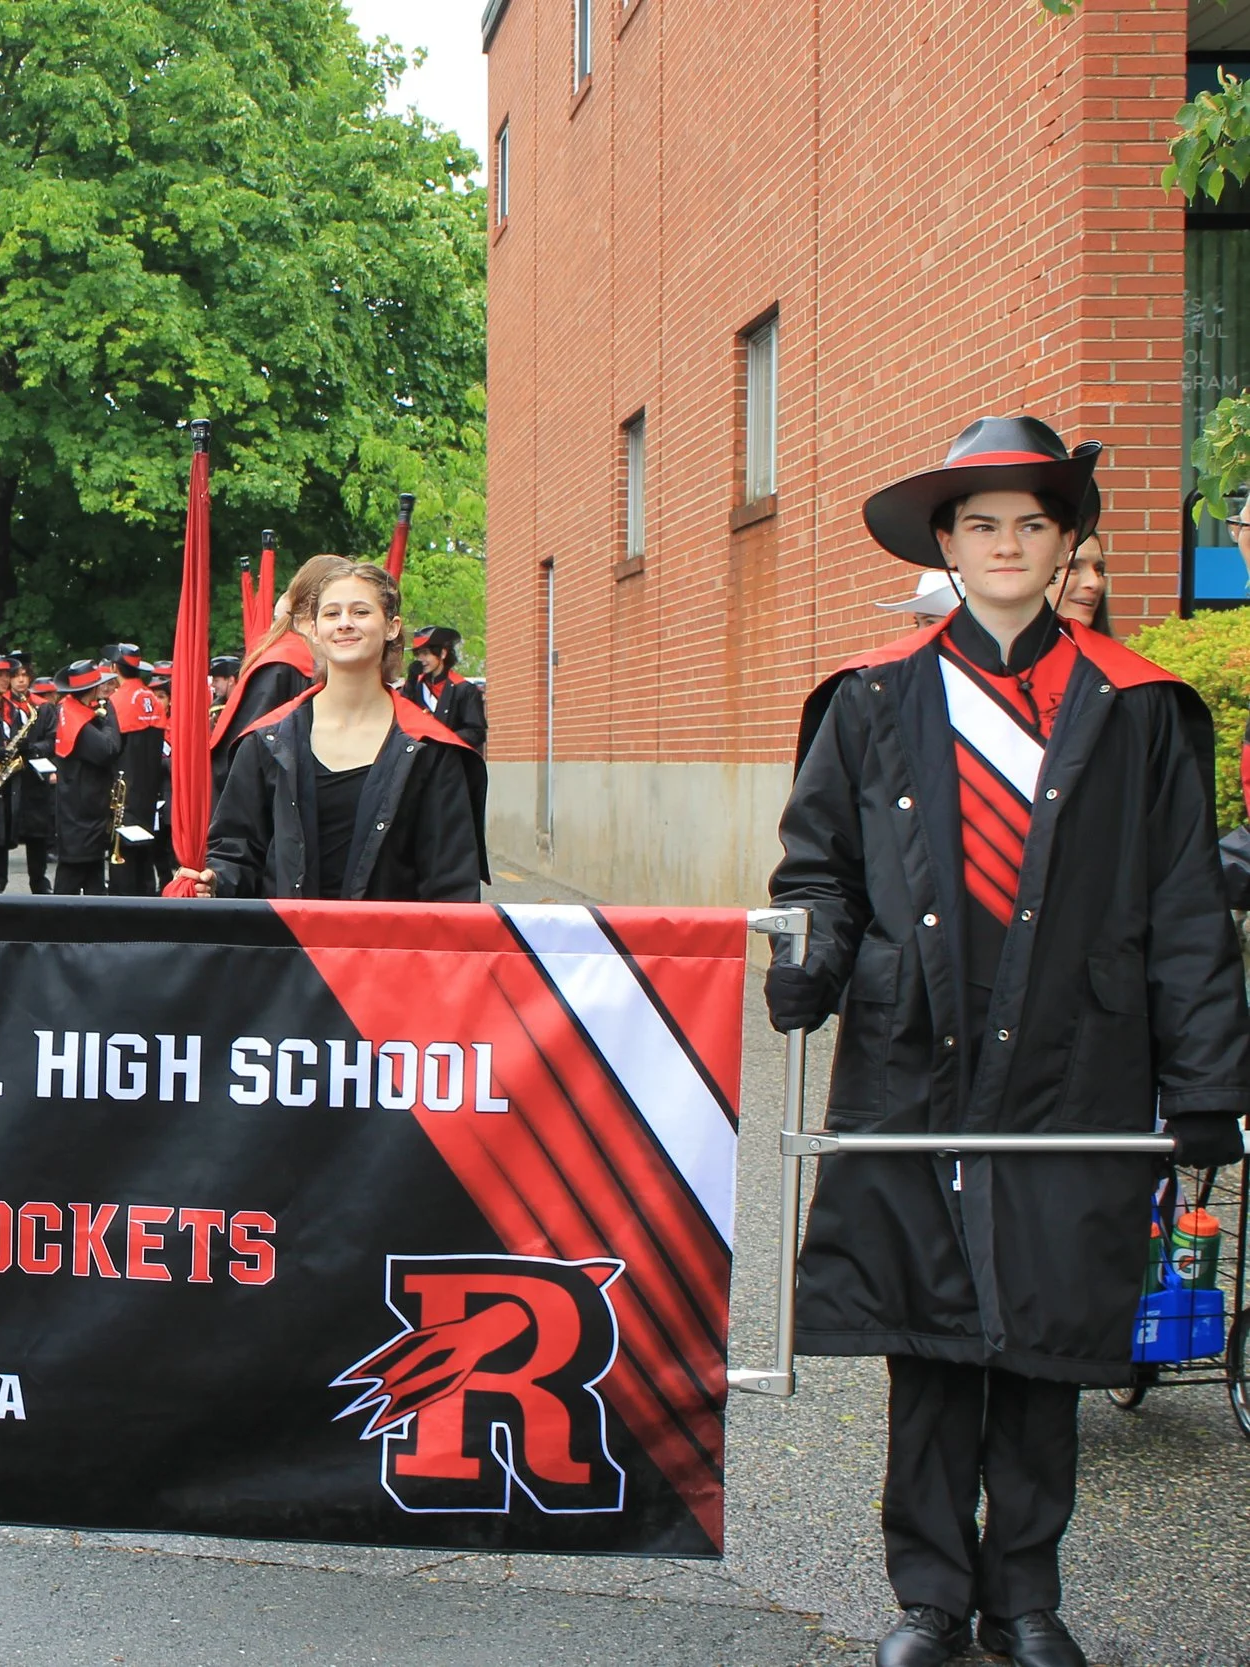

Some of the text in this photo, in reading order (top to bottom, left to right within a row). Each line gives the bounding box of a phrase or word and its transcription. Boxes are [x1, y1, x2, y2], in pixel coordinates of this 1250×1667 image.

[32, 1030, 203, 1103] HIGH
[228, 1036, 510, 1114] SCHOOL
[378, 1254, 627, 1513] R
